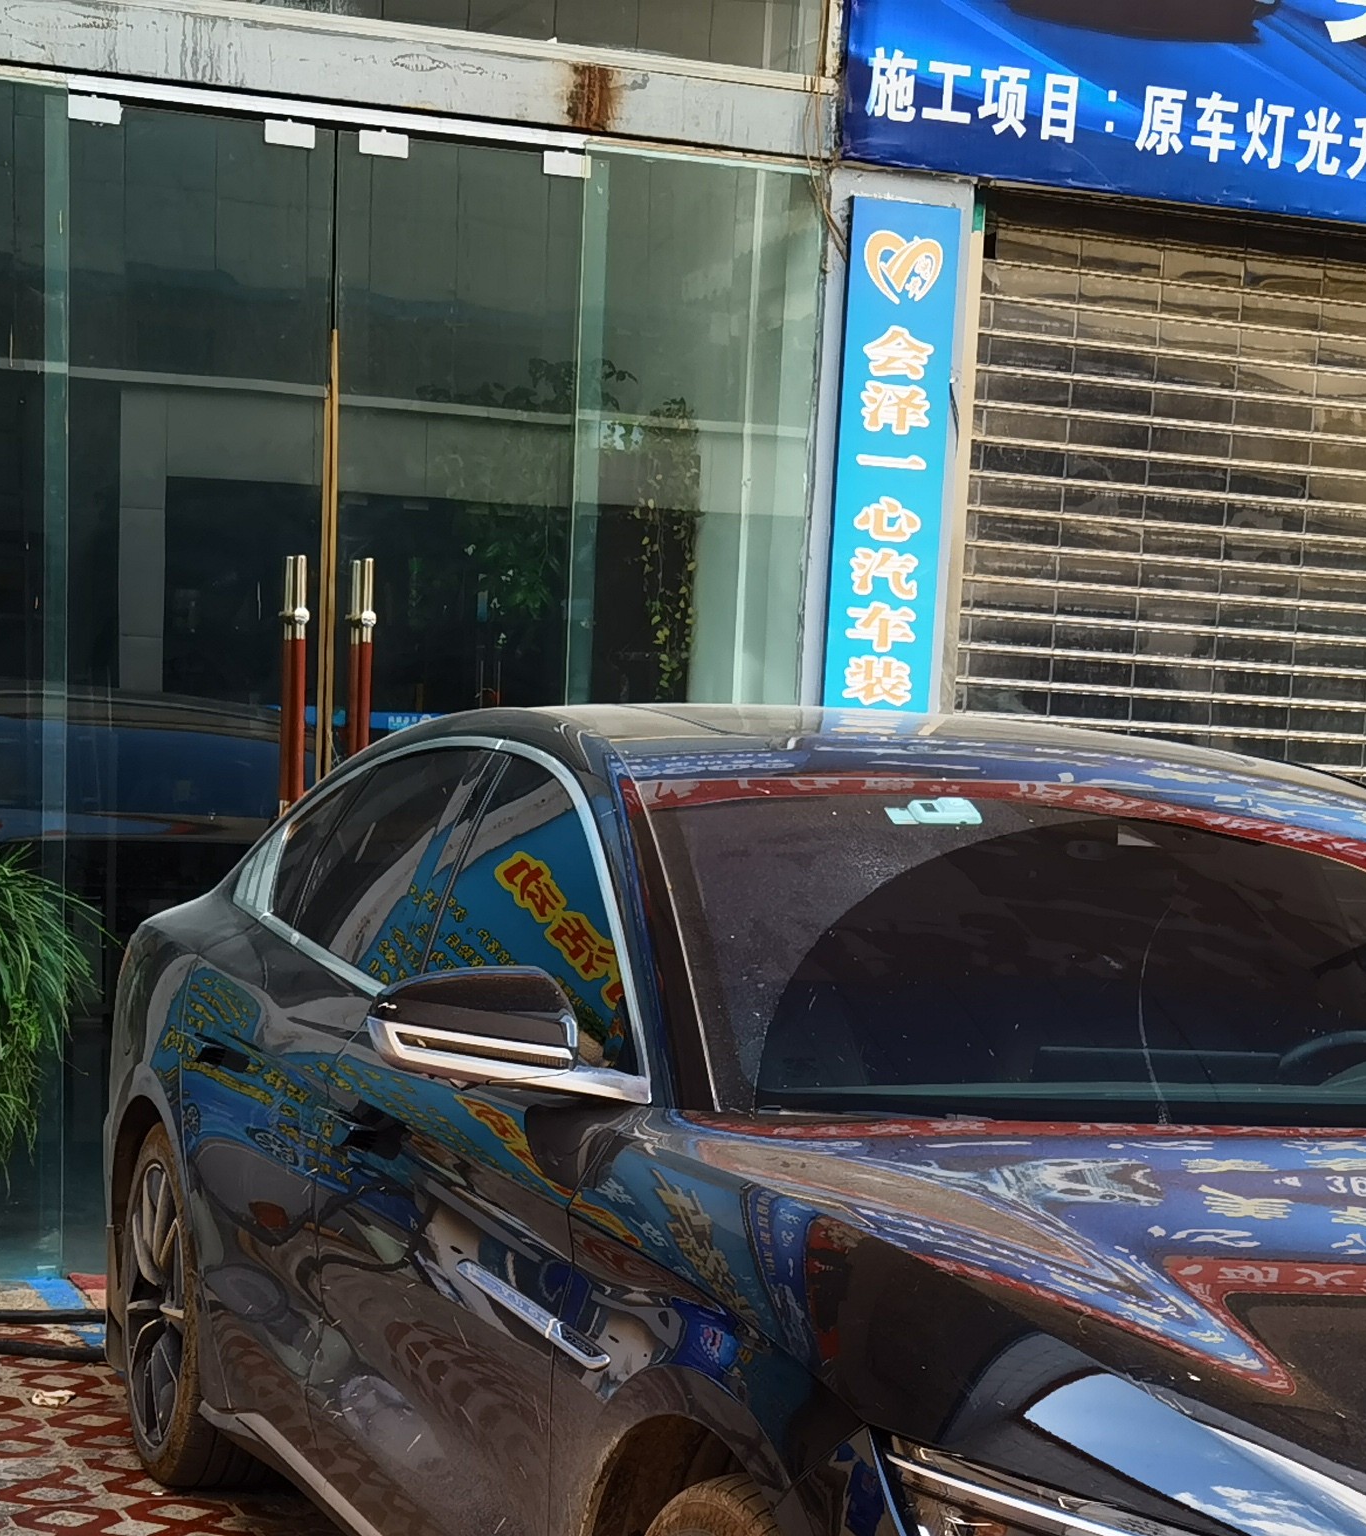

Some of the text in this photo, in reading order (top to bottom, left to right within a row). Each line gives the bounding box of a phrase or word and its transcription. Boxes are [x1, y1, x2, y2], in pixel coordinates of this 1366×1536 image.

[842, 325, 934, 707] 会泽一心汽车装
